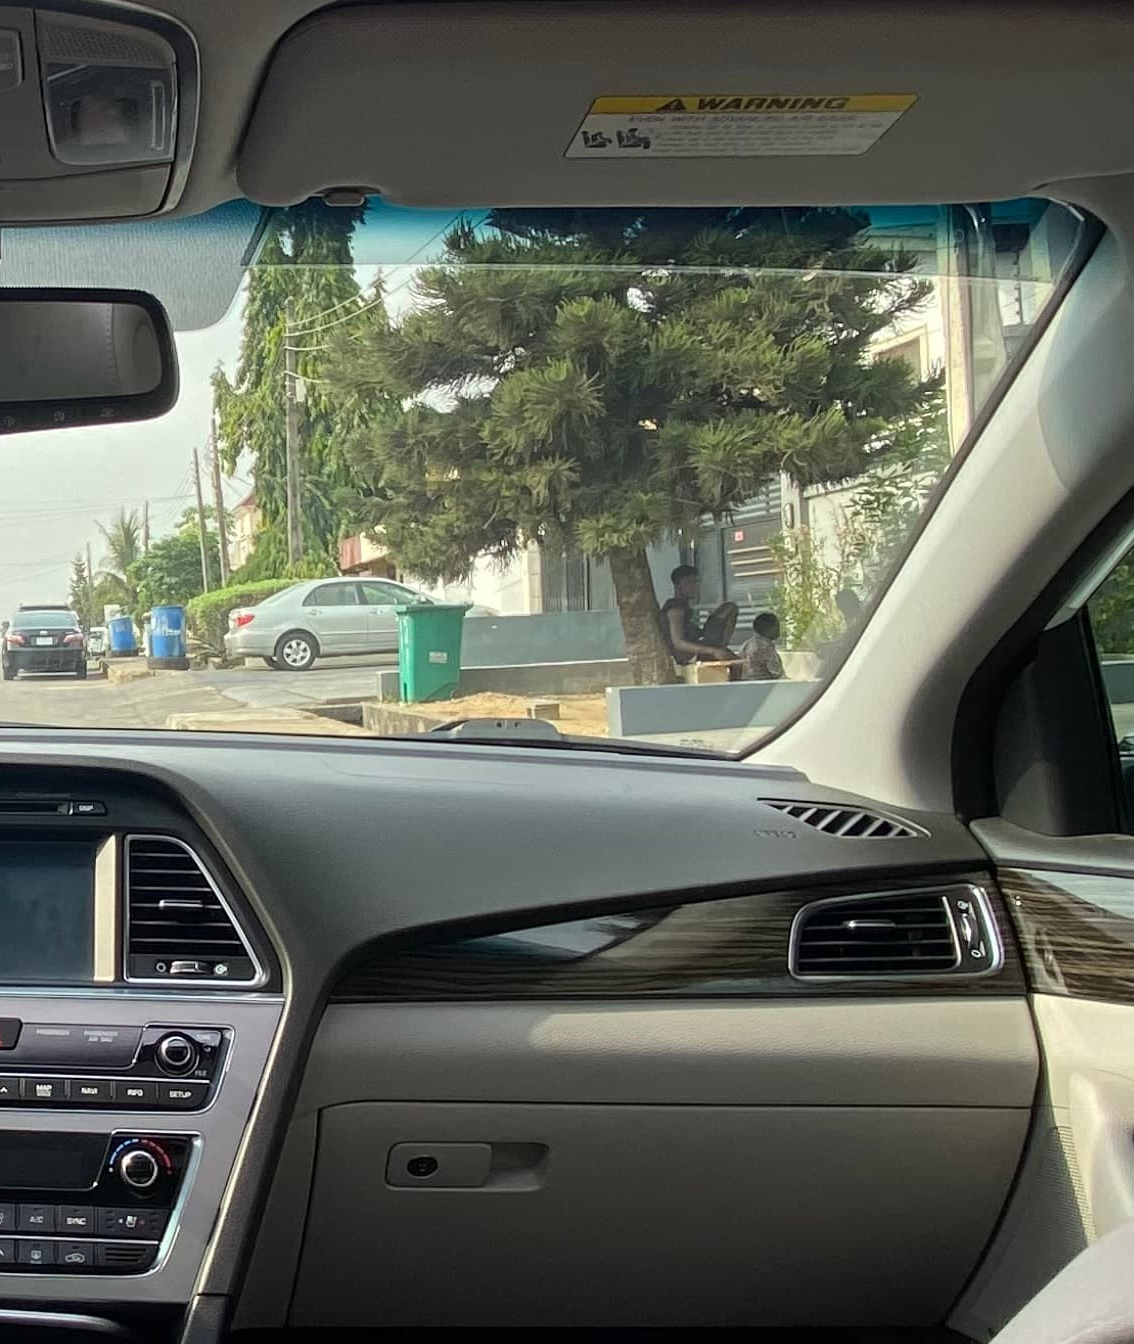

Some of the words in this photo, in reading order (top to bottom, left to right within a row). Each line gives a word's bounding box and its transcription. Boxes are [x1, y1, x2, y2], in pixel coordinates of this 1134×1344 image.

[698, 97, 850, 110] WARNING
[127, 1088, 145, 1096] INFO
[169, 1091, 192, 1099] SETUP
[29, 1215, 44, 1224] A/C
[66, 1217, 87, 1226] SYNC
